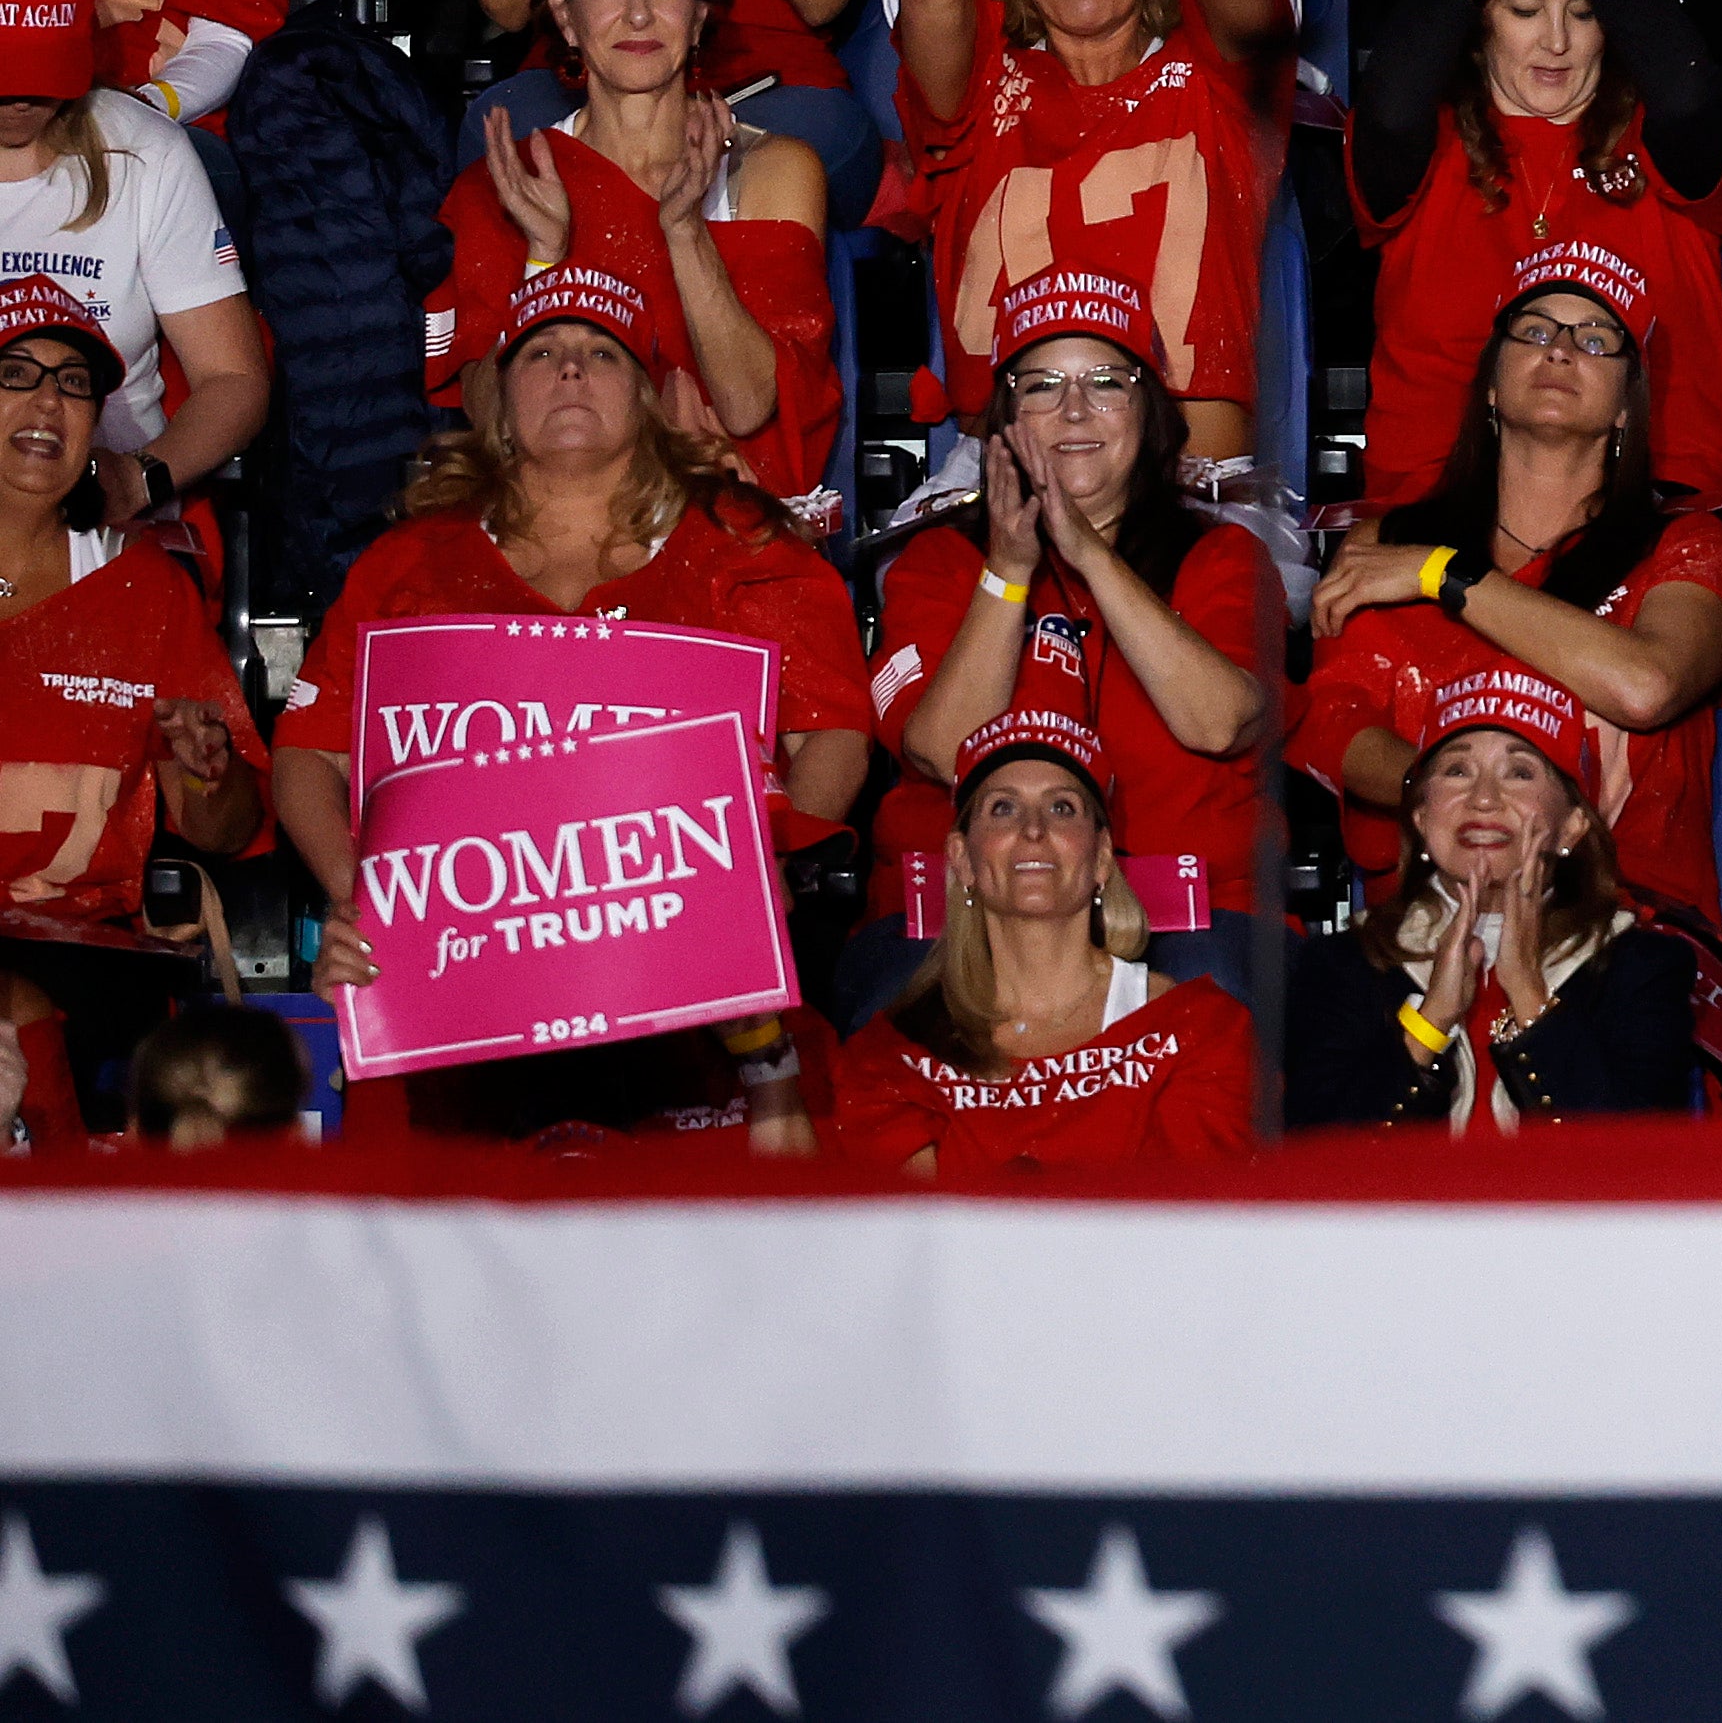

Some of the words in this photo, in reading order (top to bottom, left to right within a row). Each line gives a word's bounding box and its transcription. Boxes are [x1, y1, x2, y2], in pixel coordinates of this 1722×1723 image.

[0, 250, 104, 282] EXCELLENCE
[41, 673, 98, 692] TRUMP
[103, 678, 154, 700] FORCE
[63, 688, 134, 709] CAPTAIN
[362, 796, 732, 932] WOMEN
[429, 927, 488, 979] for
[494, 887, 683, 952] TRUMP
[533, 1013, 608, 1043] 2024
[902, 1053, 976, 1081] MA
[1019, 1031, 1180, 1081] AMERICA
[1055, 1061, 1157, 1103] AGAIN
